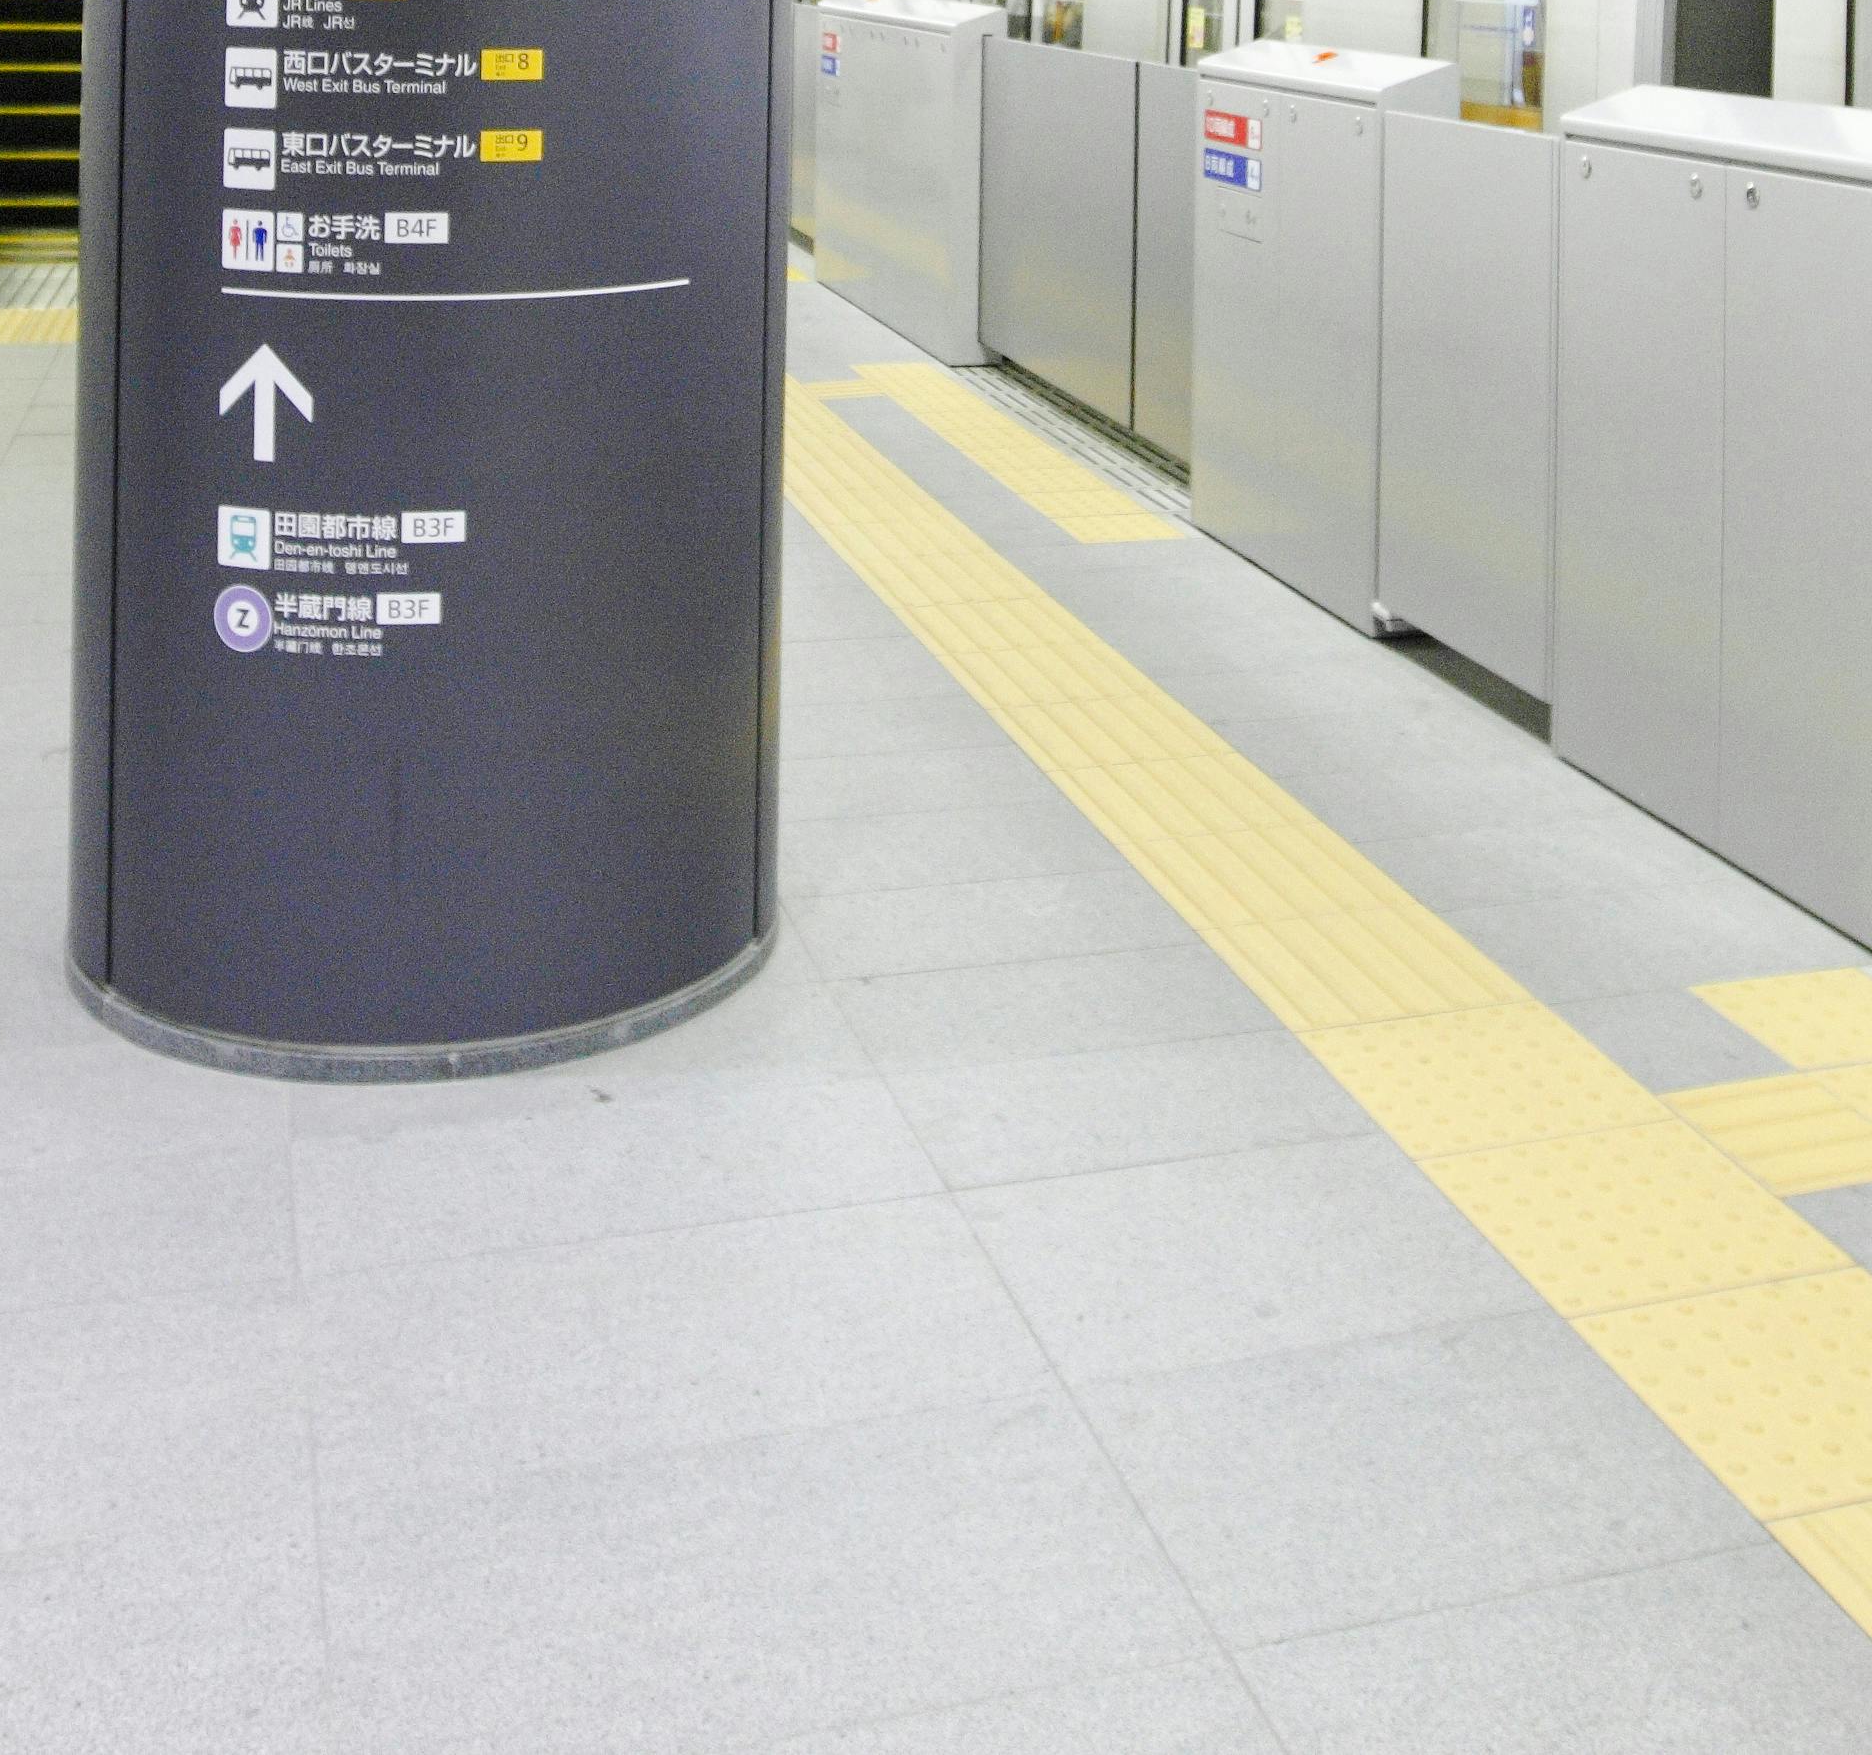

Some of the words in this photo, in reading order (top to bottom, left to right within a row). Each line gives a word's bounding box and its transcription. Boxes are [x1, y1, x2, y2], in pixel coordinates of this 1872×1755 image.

[283, 50, 477, 78] 西口バスターミナル
[495, 53, 514, 64] 出口
[516, 53, 530, 71] 8
[283, 78, 318, 93] West
[321, 79, 348, 93] Exit
[352, 79, 381, 94] Bus
[383, 80, 447, 95] Terminal
[281, 131, 477, 159] 東口バスターミナル
[495, 135, 514, 145] 出口
[516, 133, 528, 152] 9
[280, 160, 312, 174] East
[315, 161, 342, 175] Exit
[345, 161, 374, 176] Bus
[376, 162, 440, 176] Terminal
[308, 214, 381, 241] お手洗
[396, 218, 438, 238] B4F
[309, 243, 353, 258] Toilets
[274, 511, 398, 541] 田園都市線
[412, 518, 456, 538] B3F
[274, 541, 363, 558] Den-en-toshi
[366, 545, 397, 559] Line
[274, 593, 373, 622] 半蔵門線
[387, 600, 431, 620] B3F
[236, 608, 250, 629] Z
[351, 626, 383, 640] Line
